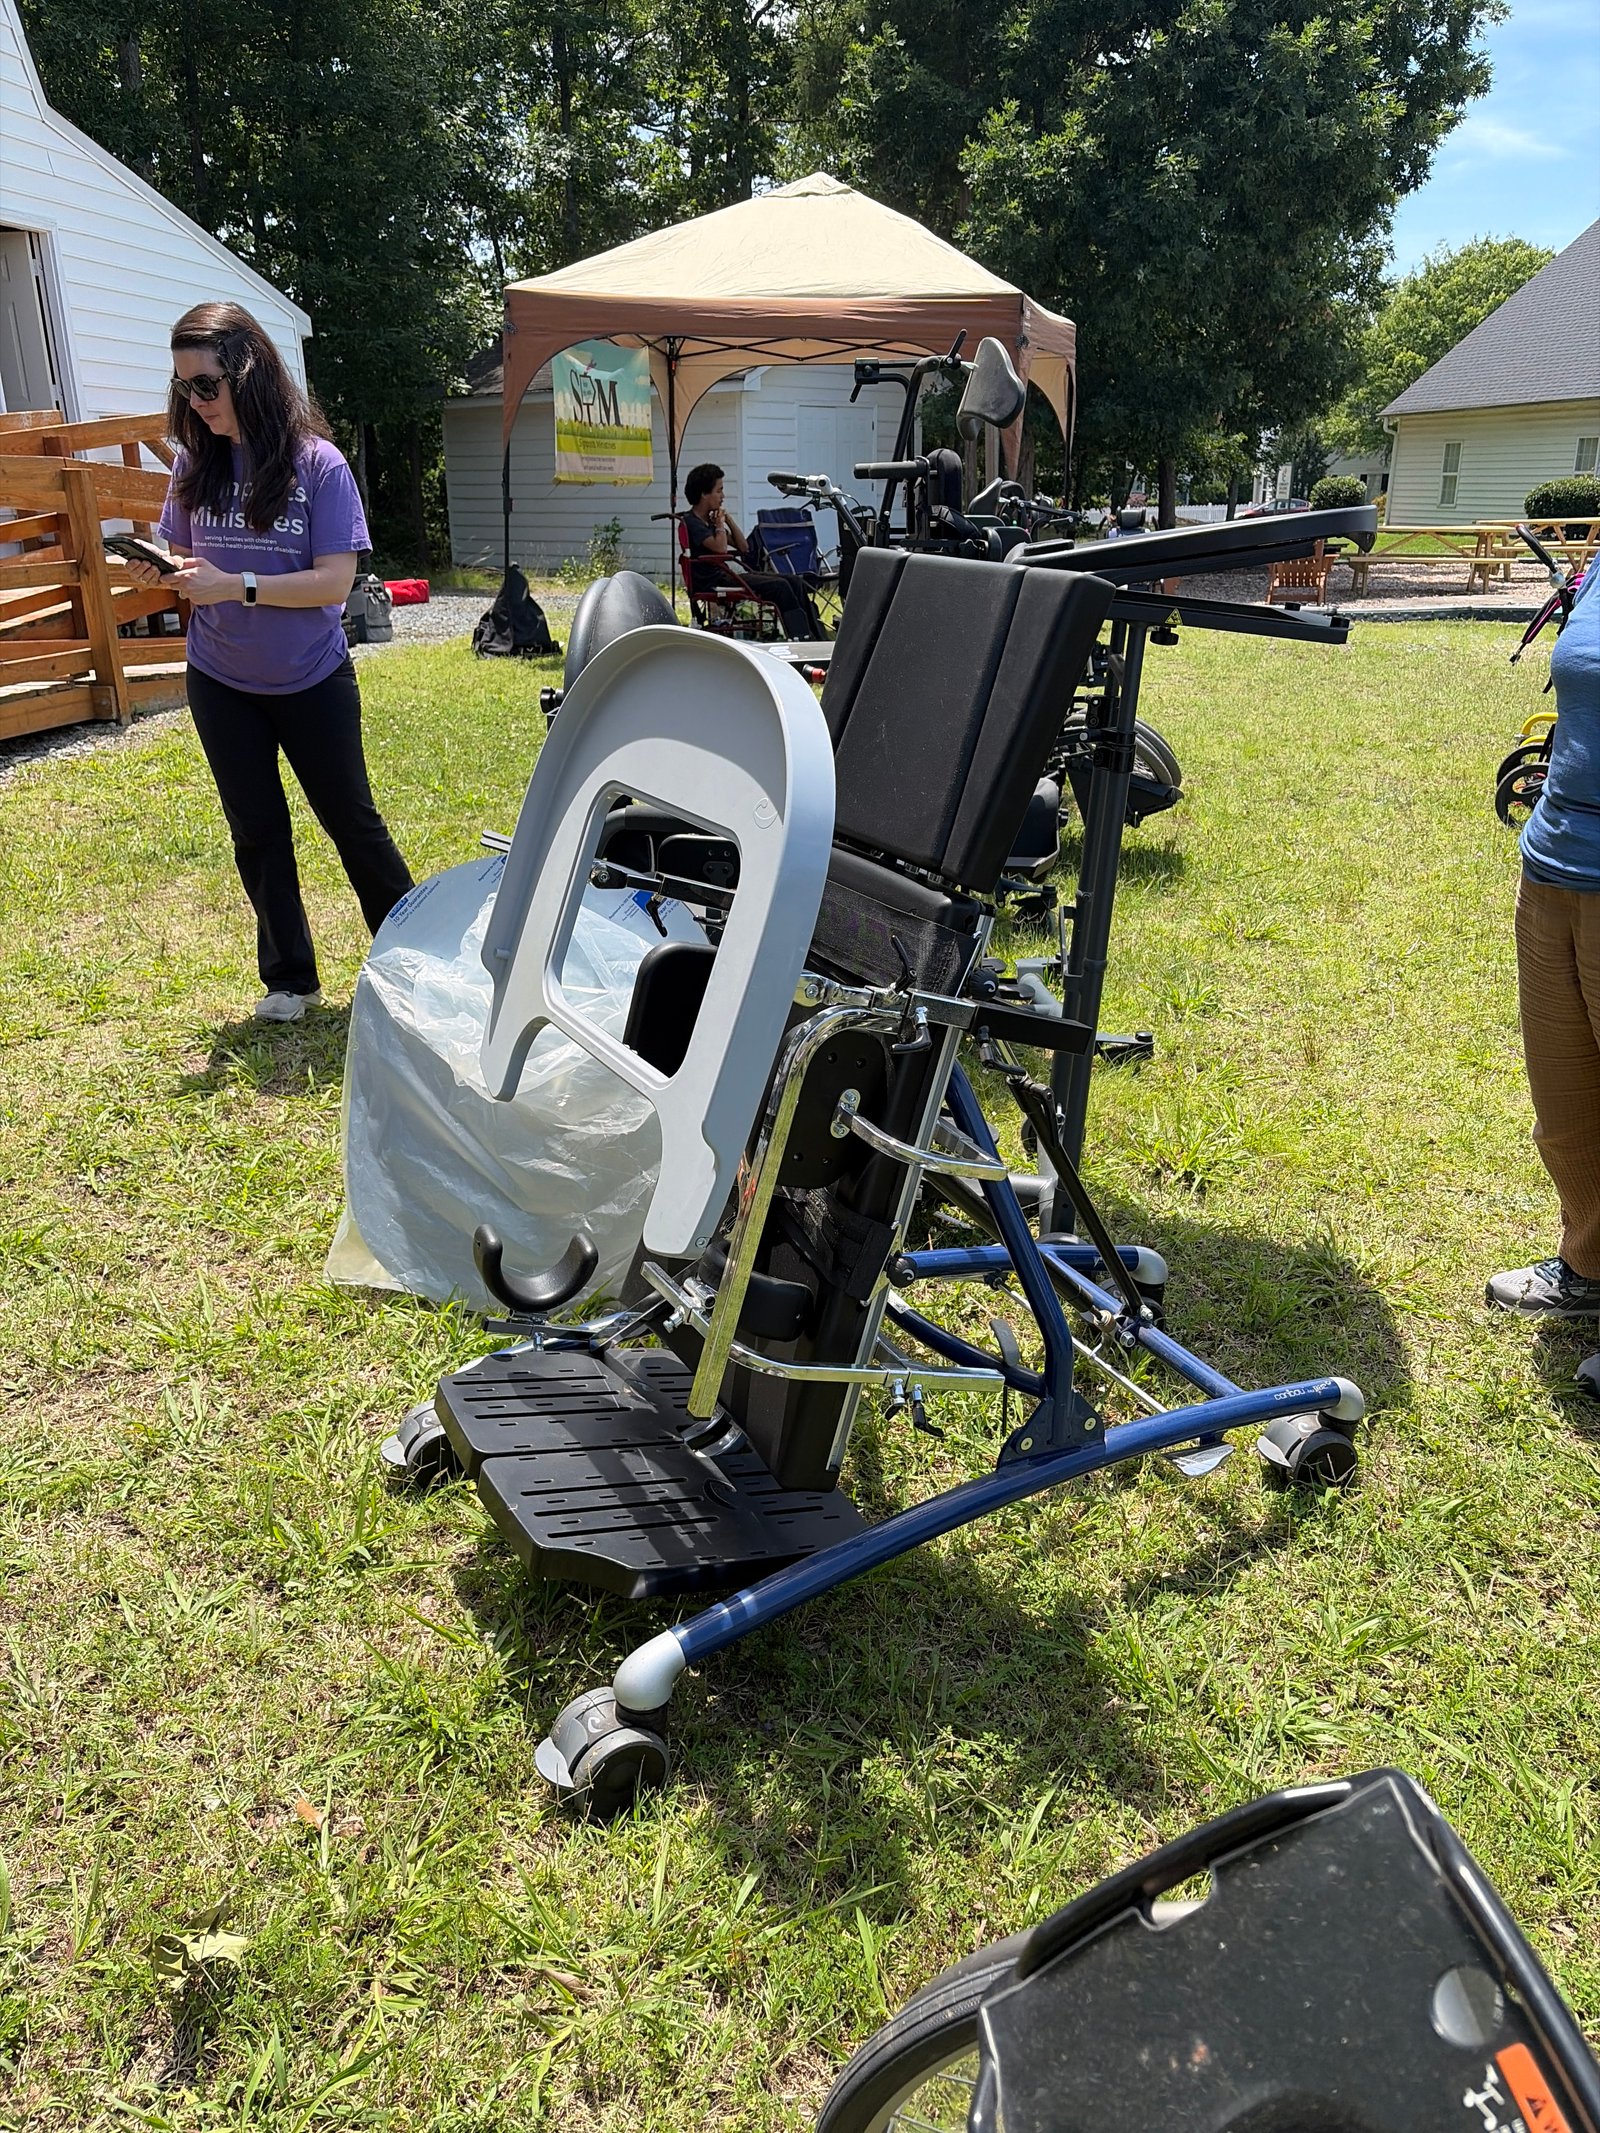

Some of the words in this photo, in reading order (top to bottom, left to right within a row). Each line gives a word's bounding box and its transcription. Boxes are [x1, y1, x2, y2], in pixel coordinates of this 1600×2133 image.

[190, 506, 304, 535] Minises
[255, 537, 277, 545] children
[399, 906, 409, 916] Year
[407, 885, 428, 907] Guarantee
